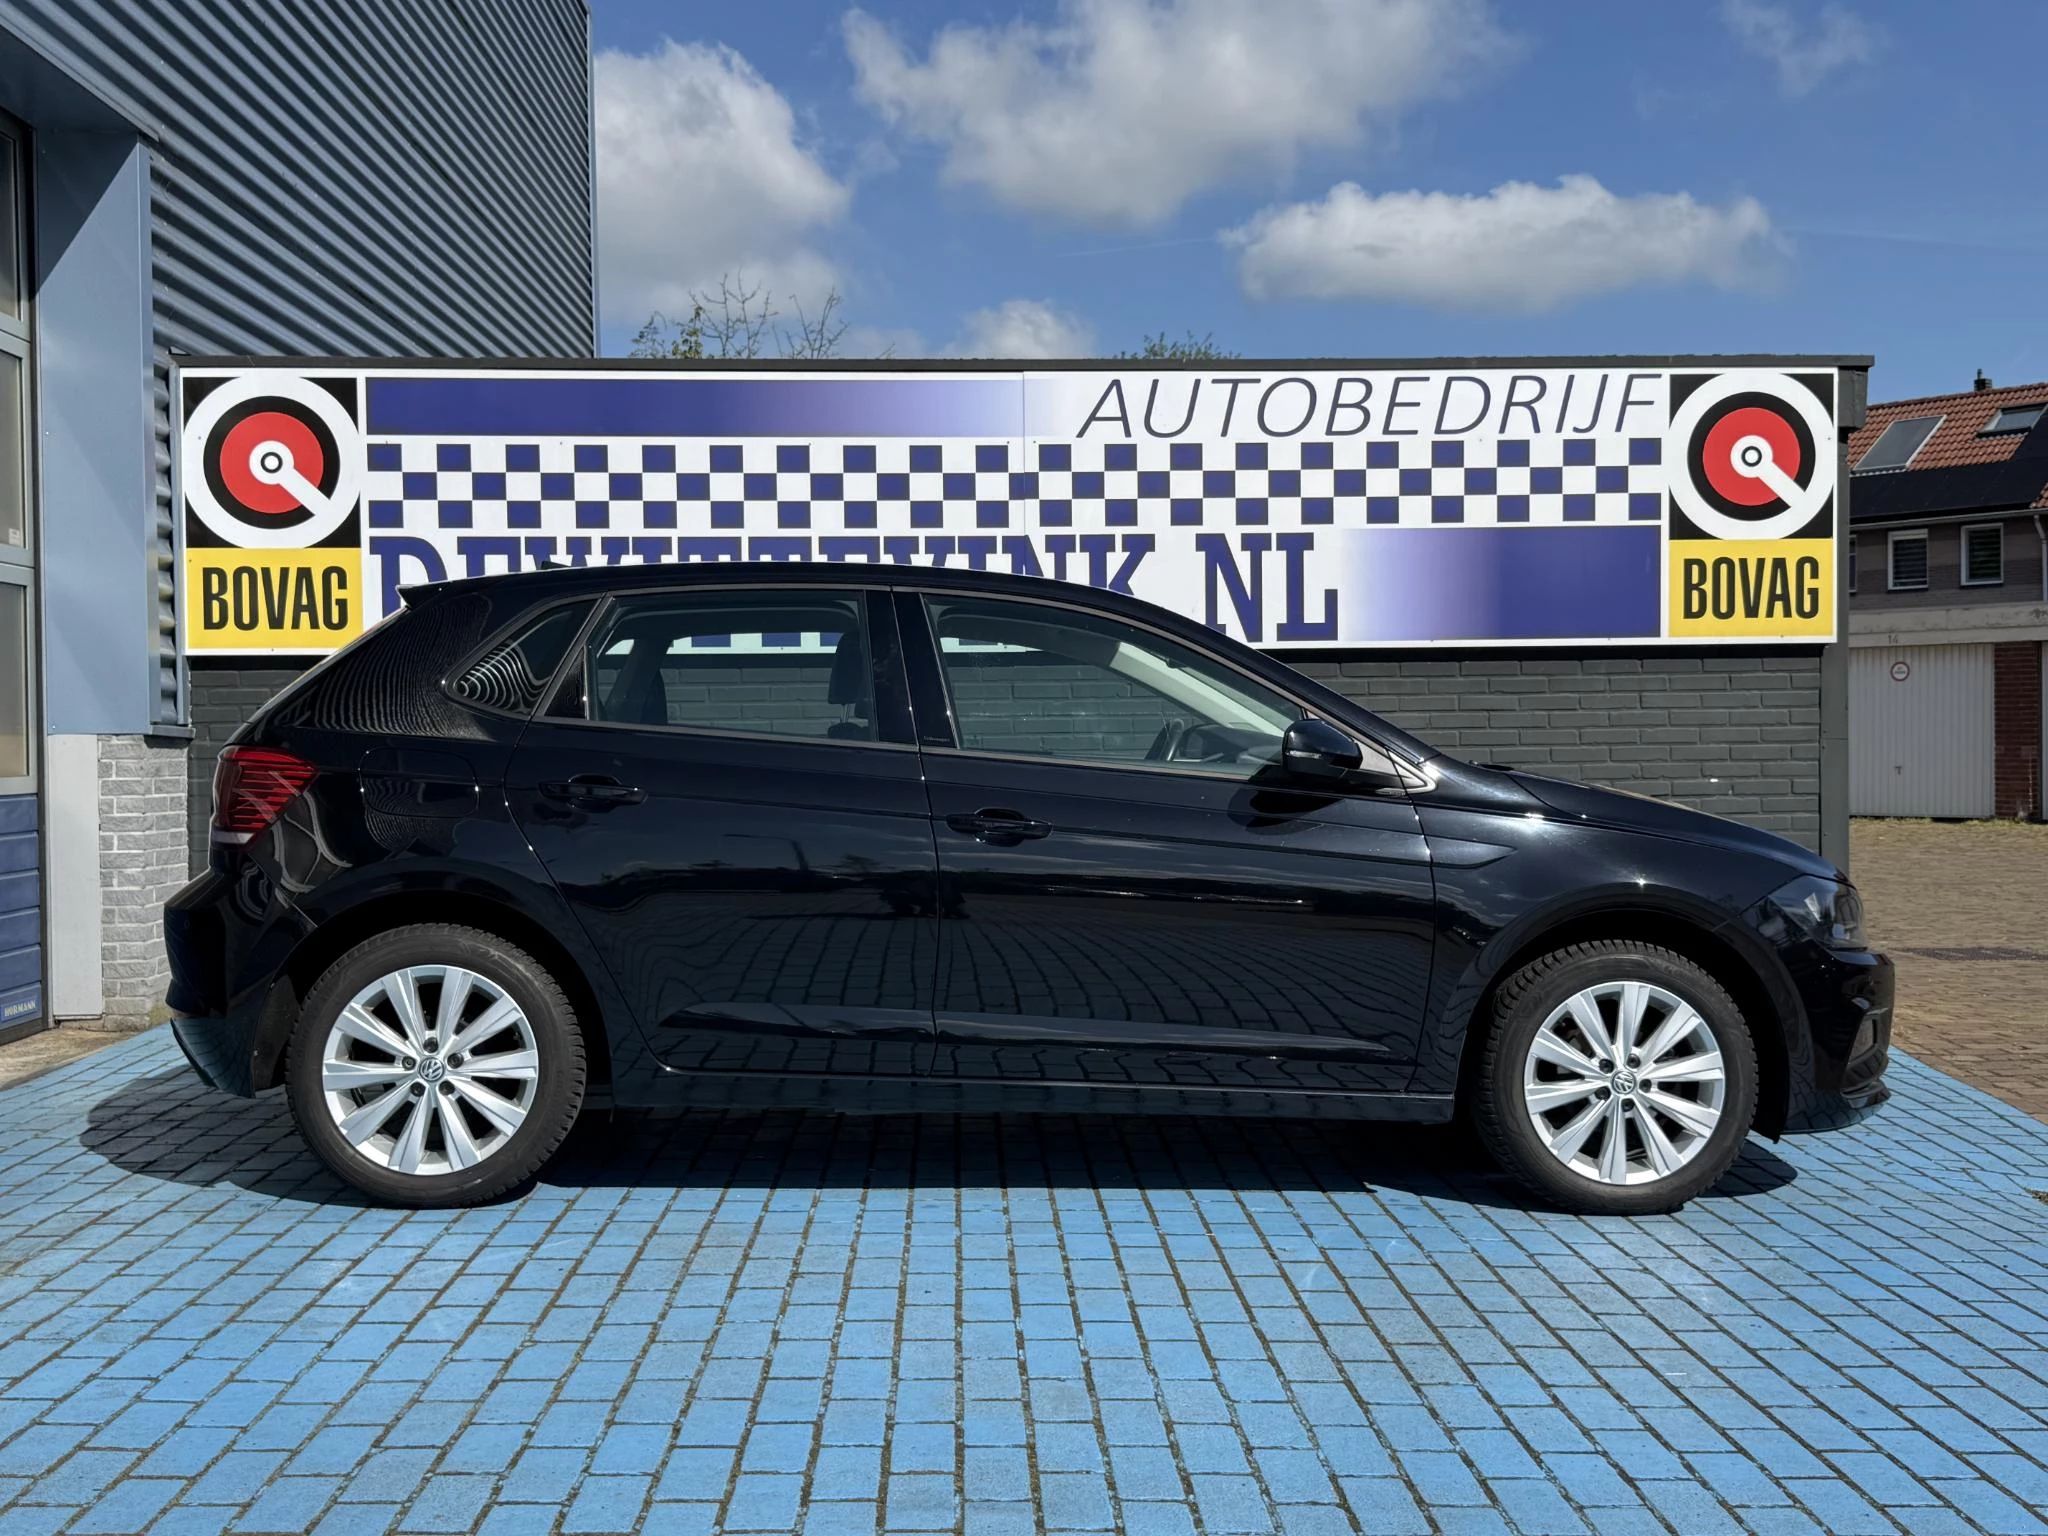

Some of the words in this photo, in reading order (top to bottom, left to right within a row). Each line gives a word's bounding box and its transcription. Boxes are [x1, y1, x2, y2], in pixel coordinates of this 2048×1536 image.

[1076, 373, 1662, 439] AUTOBEDRIJF
[202, 566, 348, 631] BOVAG
[1683, 556, 1819, 620] BOVAG
